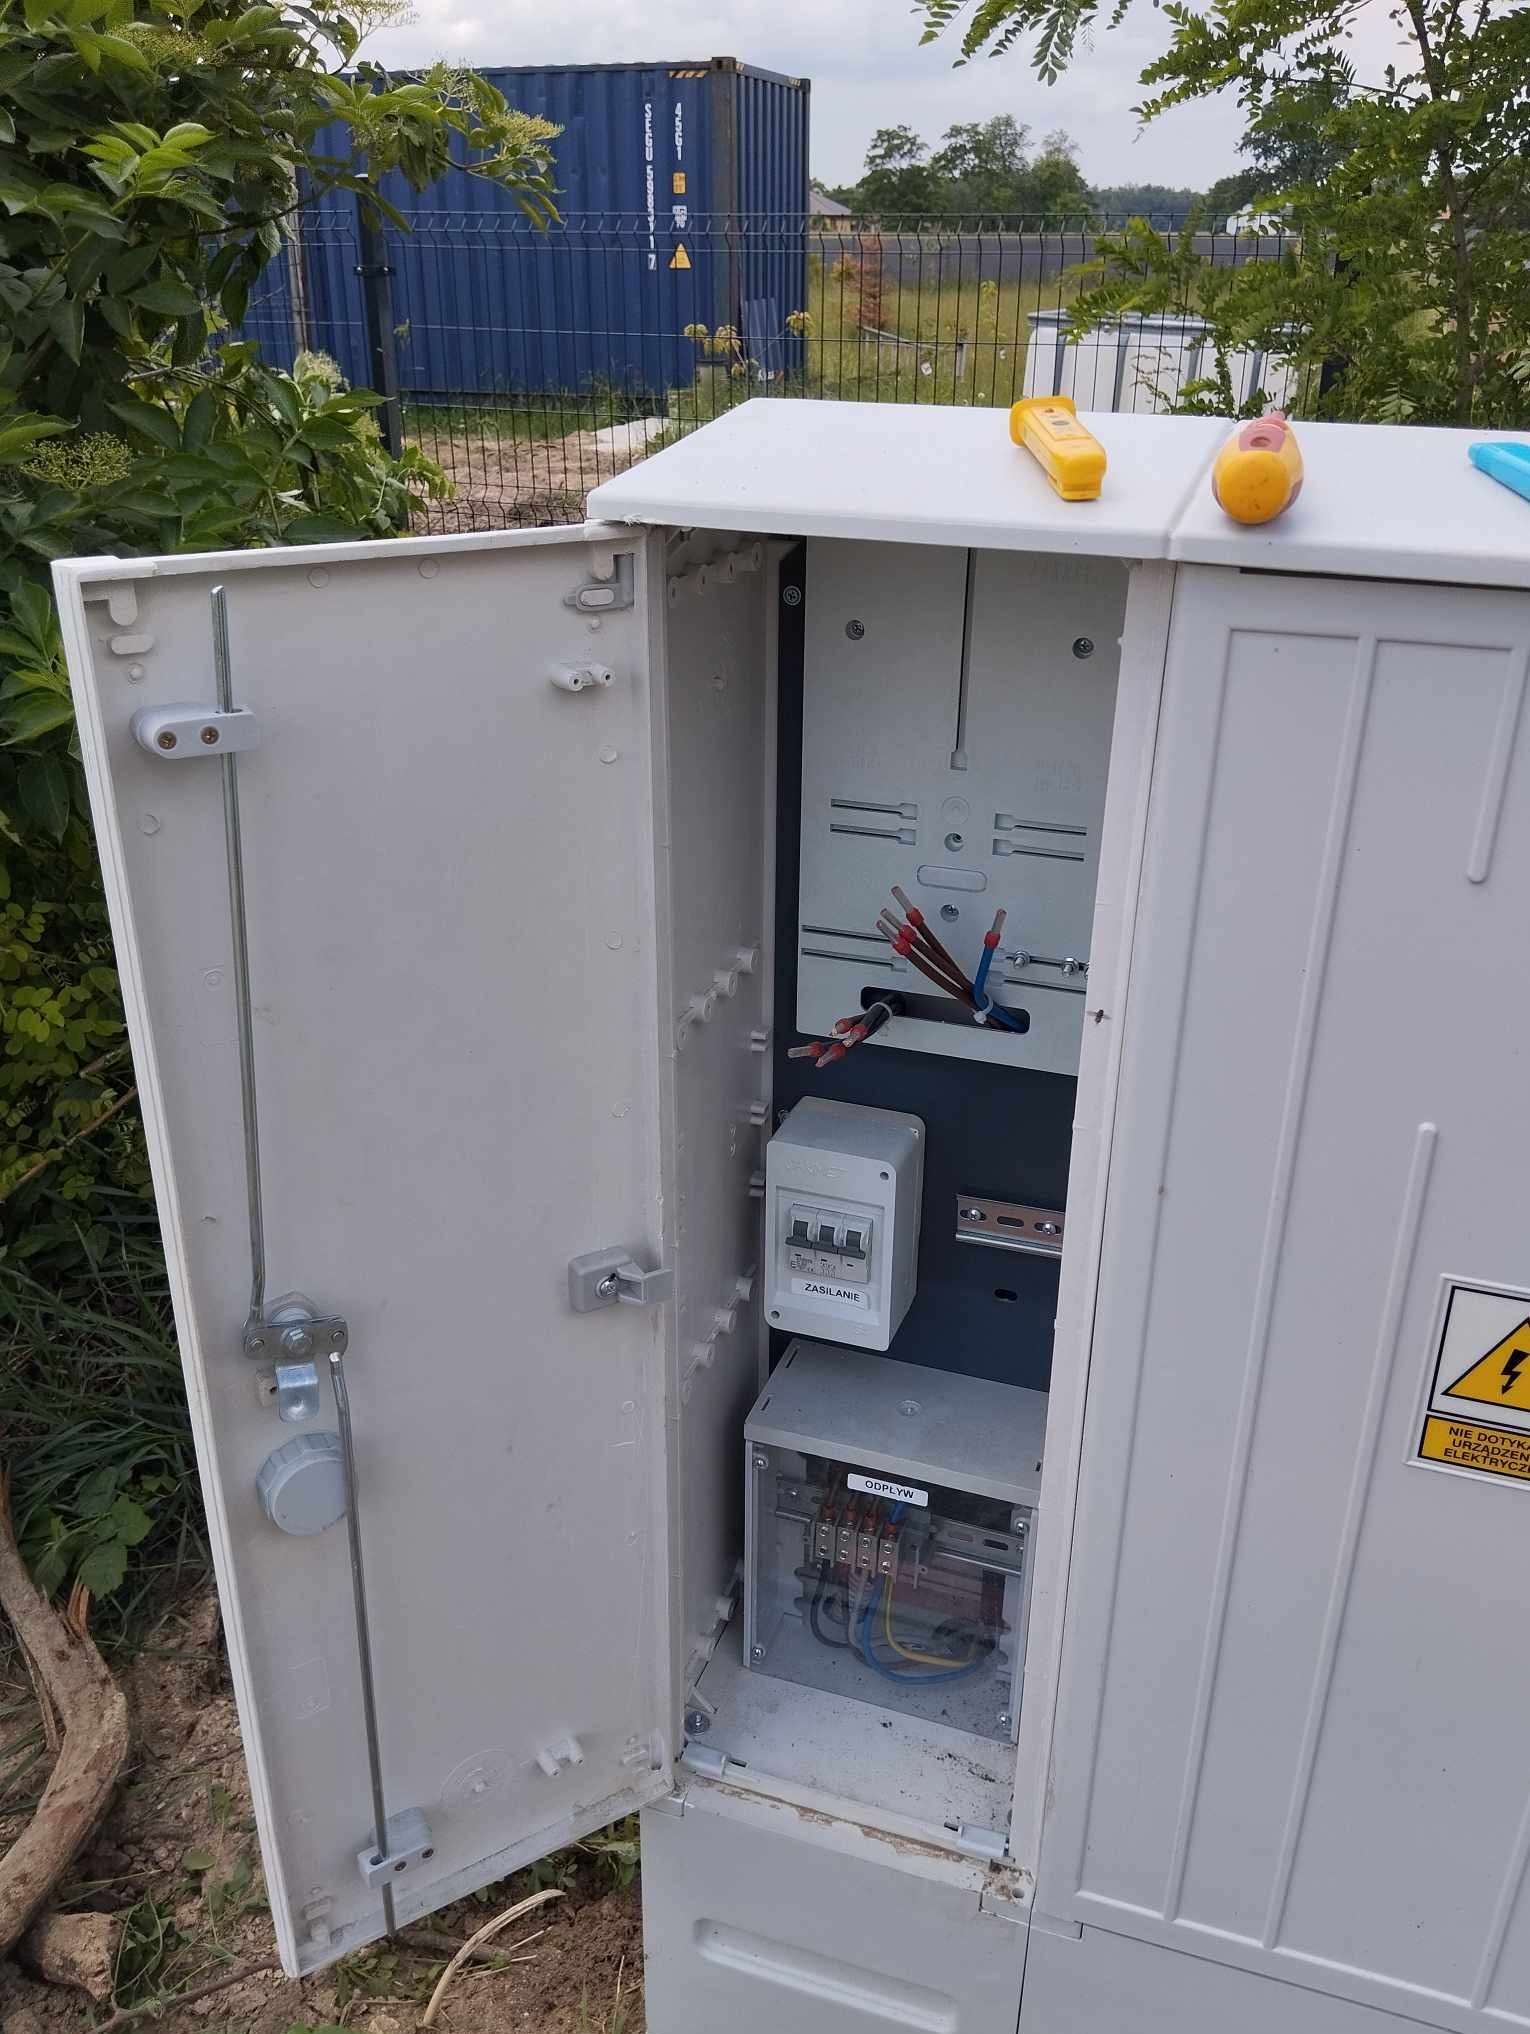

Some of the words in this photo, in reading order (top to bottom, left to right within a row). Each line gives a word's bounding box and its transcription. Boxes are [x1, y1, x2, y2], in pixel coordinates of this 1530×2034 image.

[645, 103, 653, 161] SEGU
[648, 253, 657, 271] 7
[804, 1283, 861, 1303] ZASILANIE
[1449, 1427, 1473, 1439] NIE
[1443, 1447, 1530, 1473] ELEKTRYCZ
[865, 1480, 914, 1498] ODPŁYW
